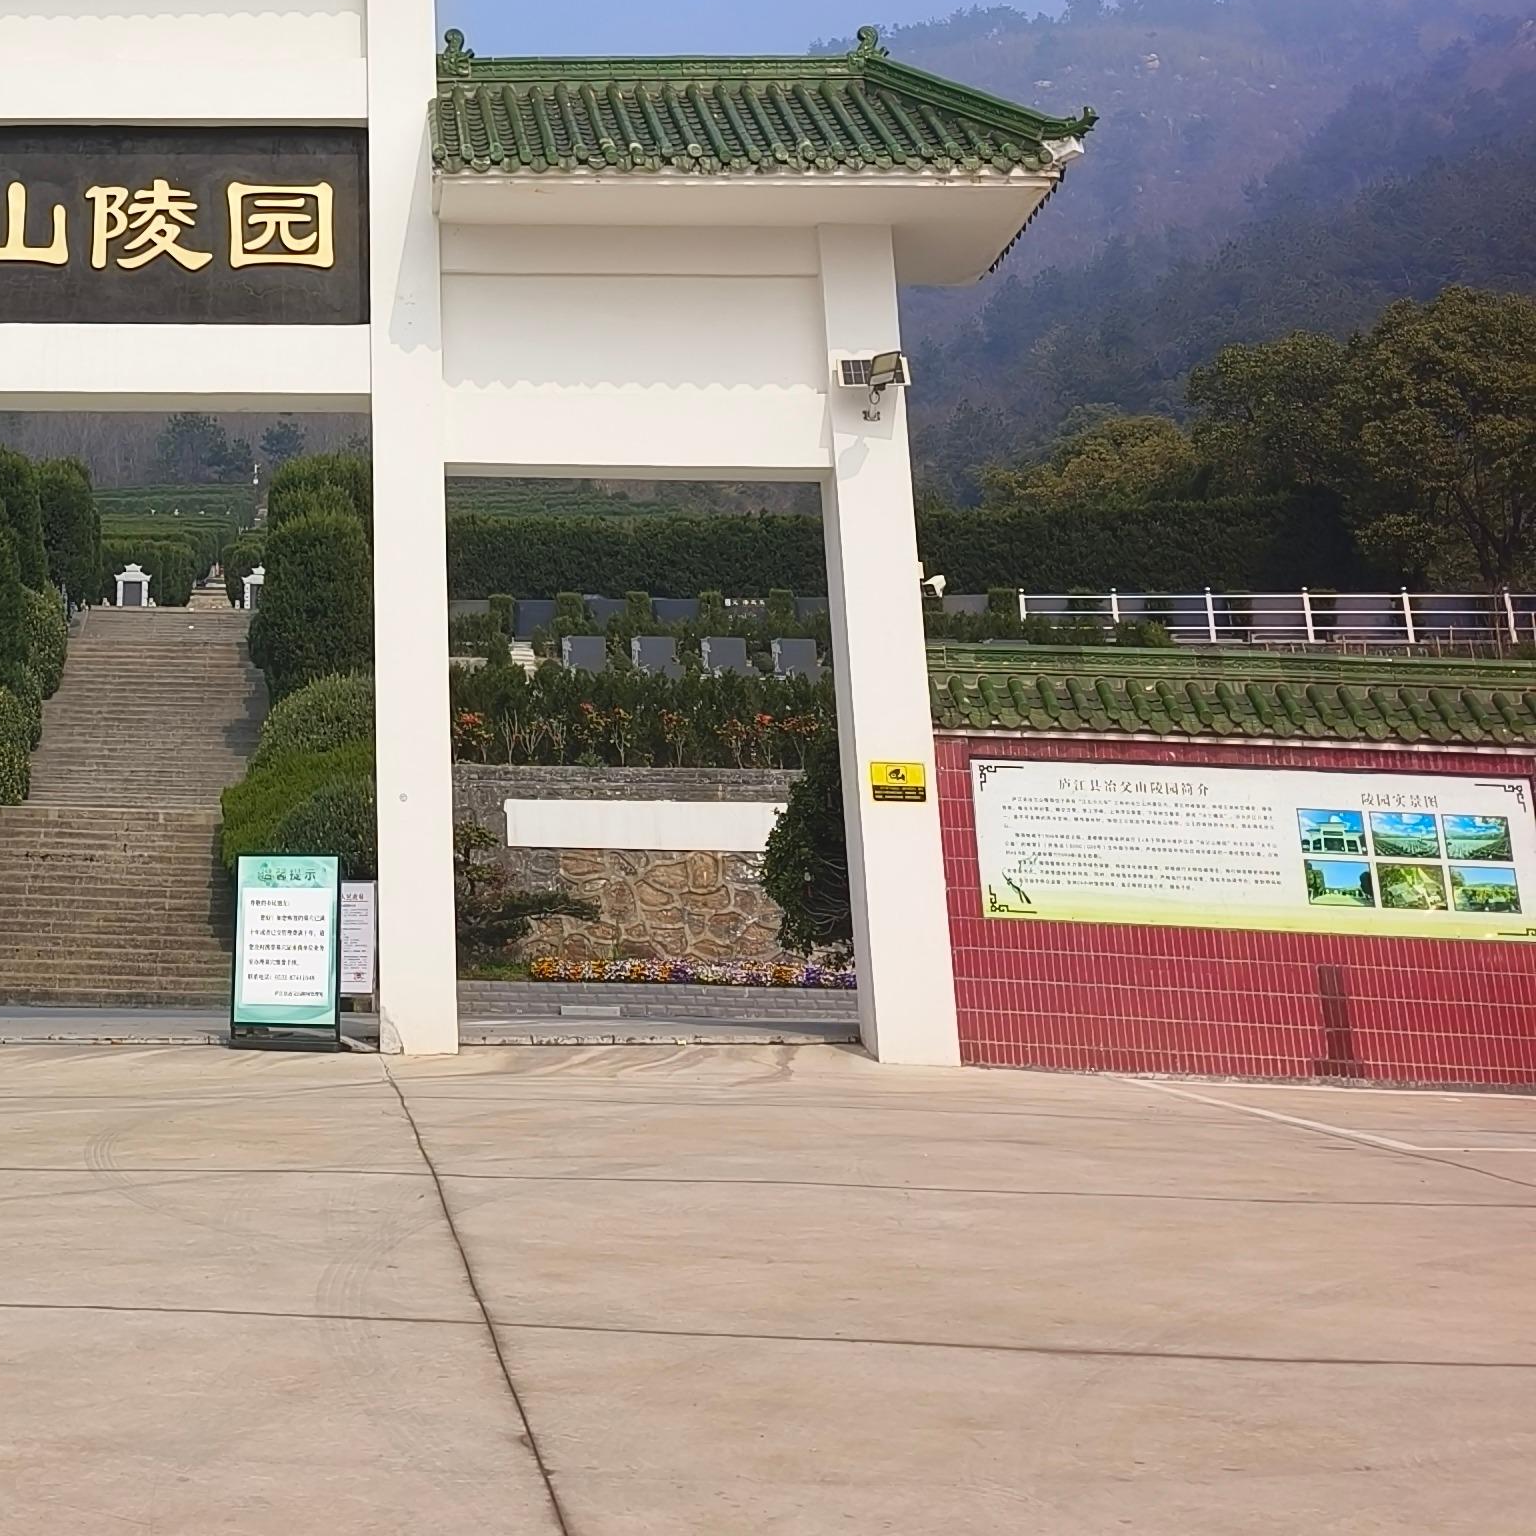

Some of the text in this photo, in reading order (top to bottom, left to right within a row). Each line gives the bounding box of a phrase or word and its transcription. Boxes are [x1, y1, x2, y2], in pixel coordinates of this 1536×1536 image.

[1059, 777, 1209, 796] 庐江县冶父山陵园简介
[1360, 792, 1439, 809] 陵园实景图
